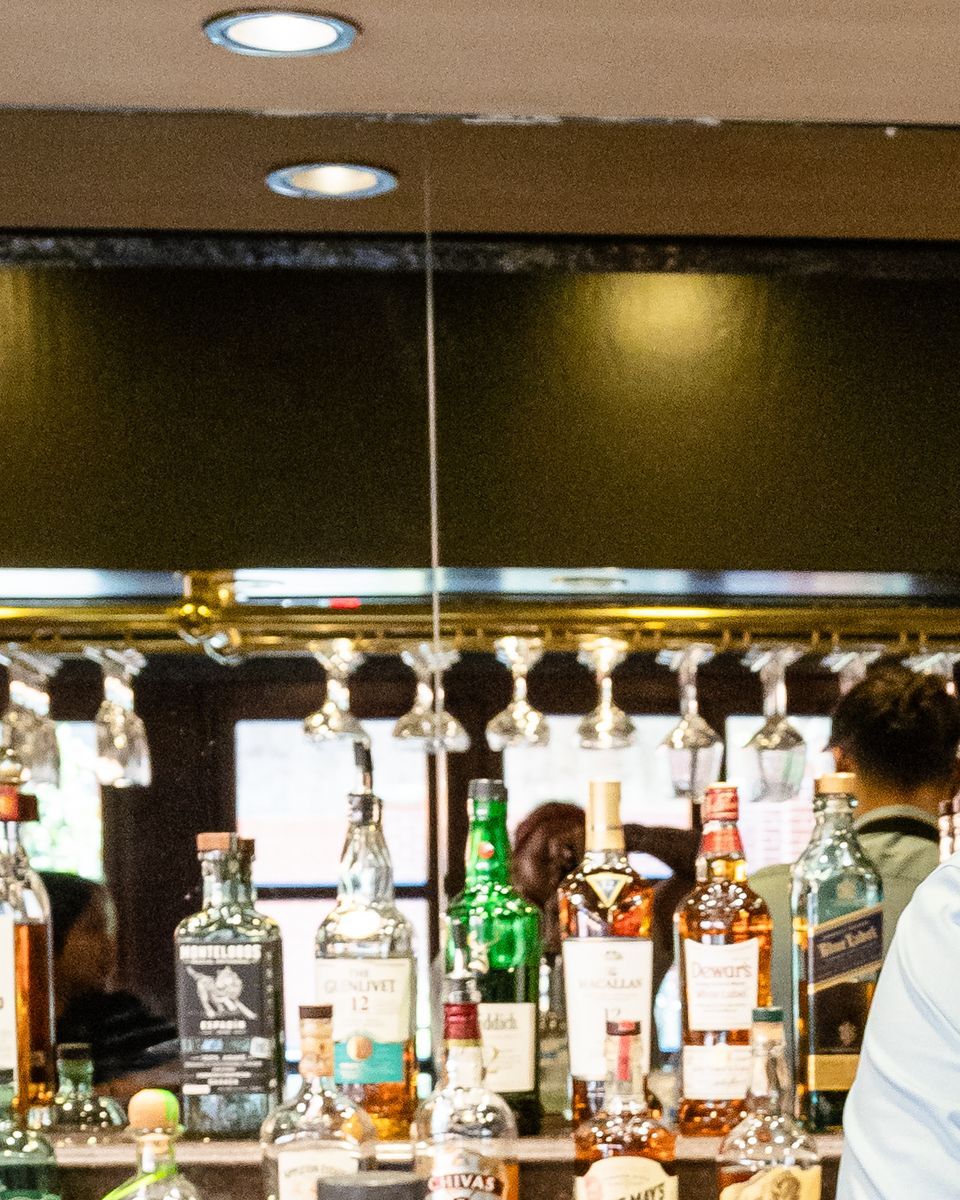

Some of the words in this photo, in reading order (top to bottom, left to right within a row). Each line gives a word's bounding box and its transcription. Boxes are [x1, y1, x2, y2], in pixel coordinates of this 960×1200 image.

[691, 961, 753, 978] Dewar's
[324, 979, 397, 994] GLENLIVET
[352, 996, 369, 1012] 12
